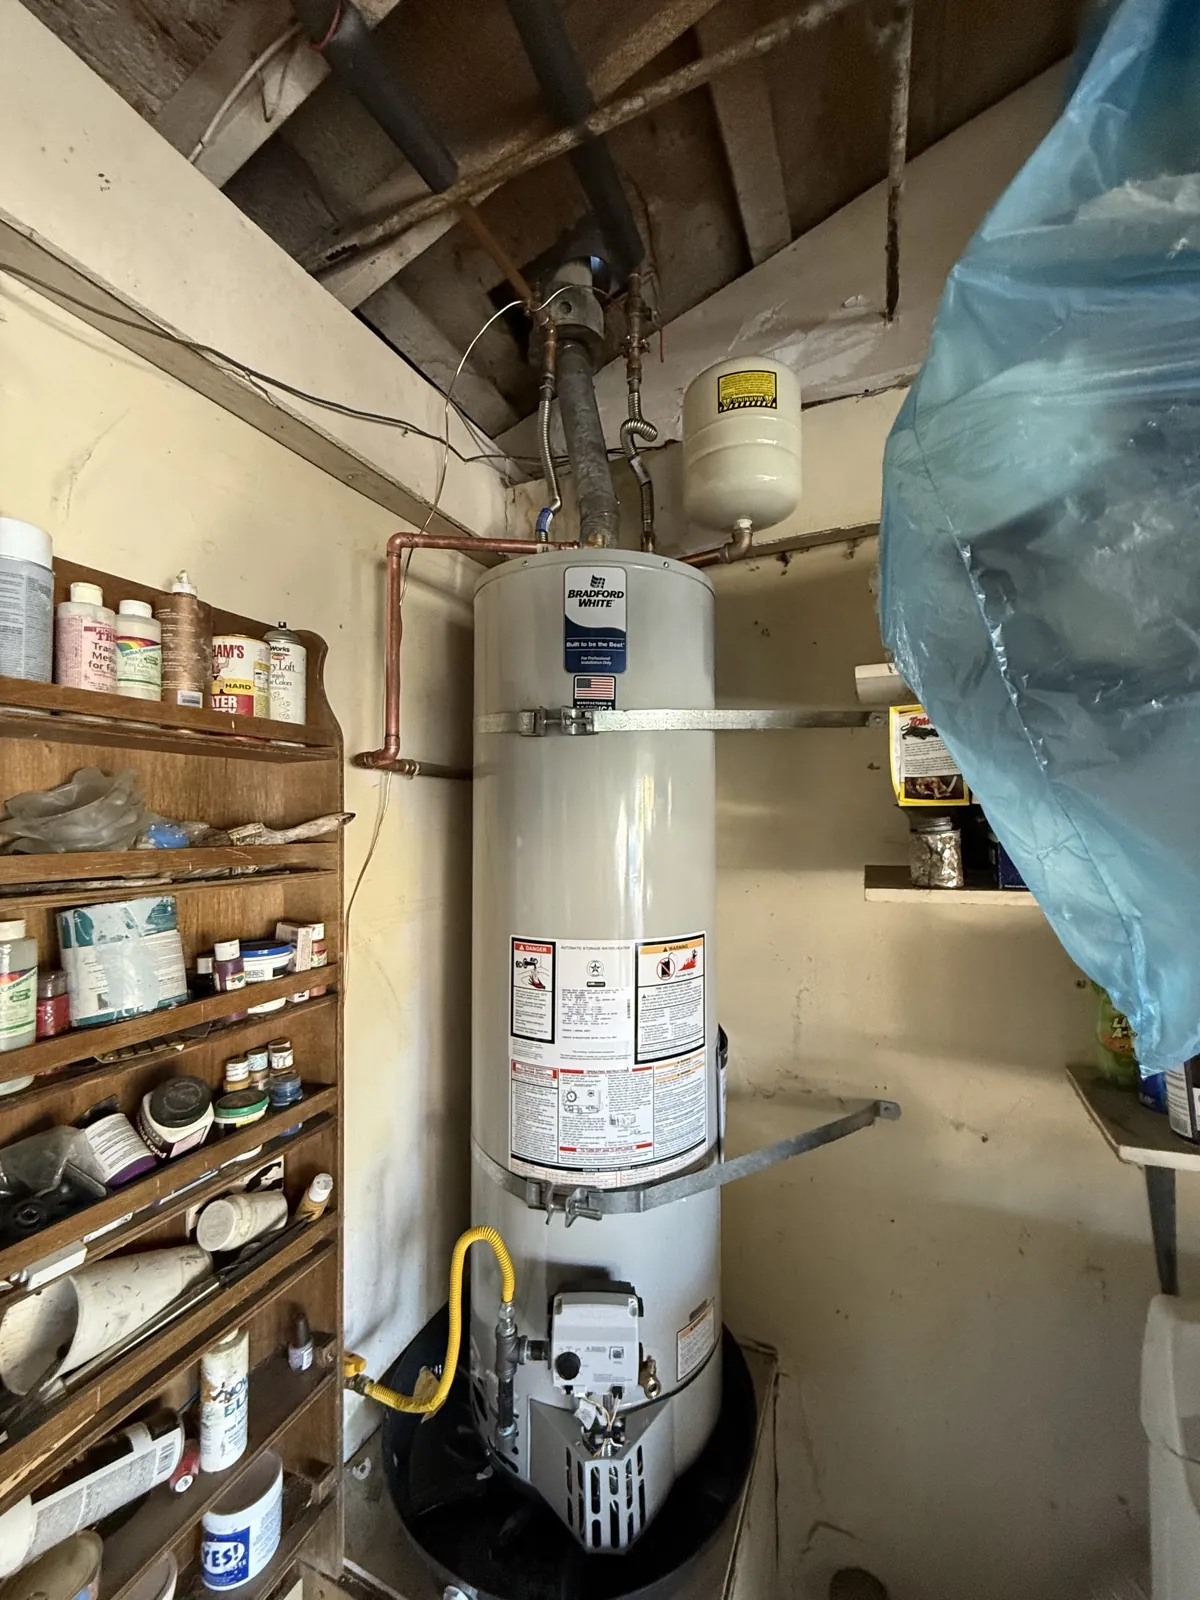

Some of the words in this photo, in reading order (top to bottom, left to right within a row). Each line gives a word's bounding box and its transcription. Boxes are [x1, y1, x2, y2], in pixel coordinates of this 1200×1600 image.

[567, 589, 624, 599] BRADFORD
[578, 599, 613, 608] WHITE
[88, 659, 104, 670] for
[279, 660, 295, 672] Loft
[203, 1543, 239, 1567] YES!
